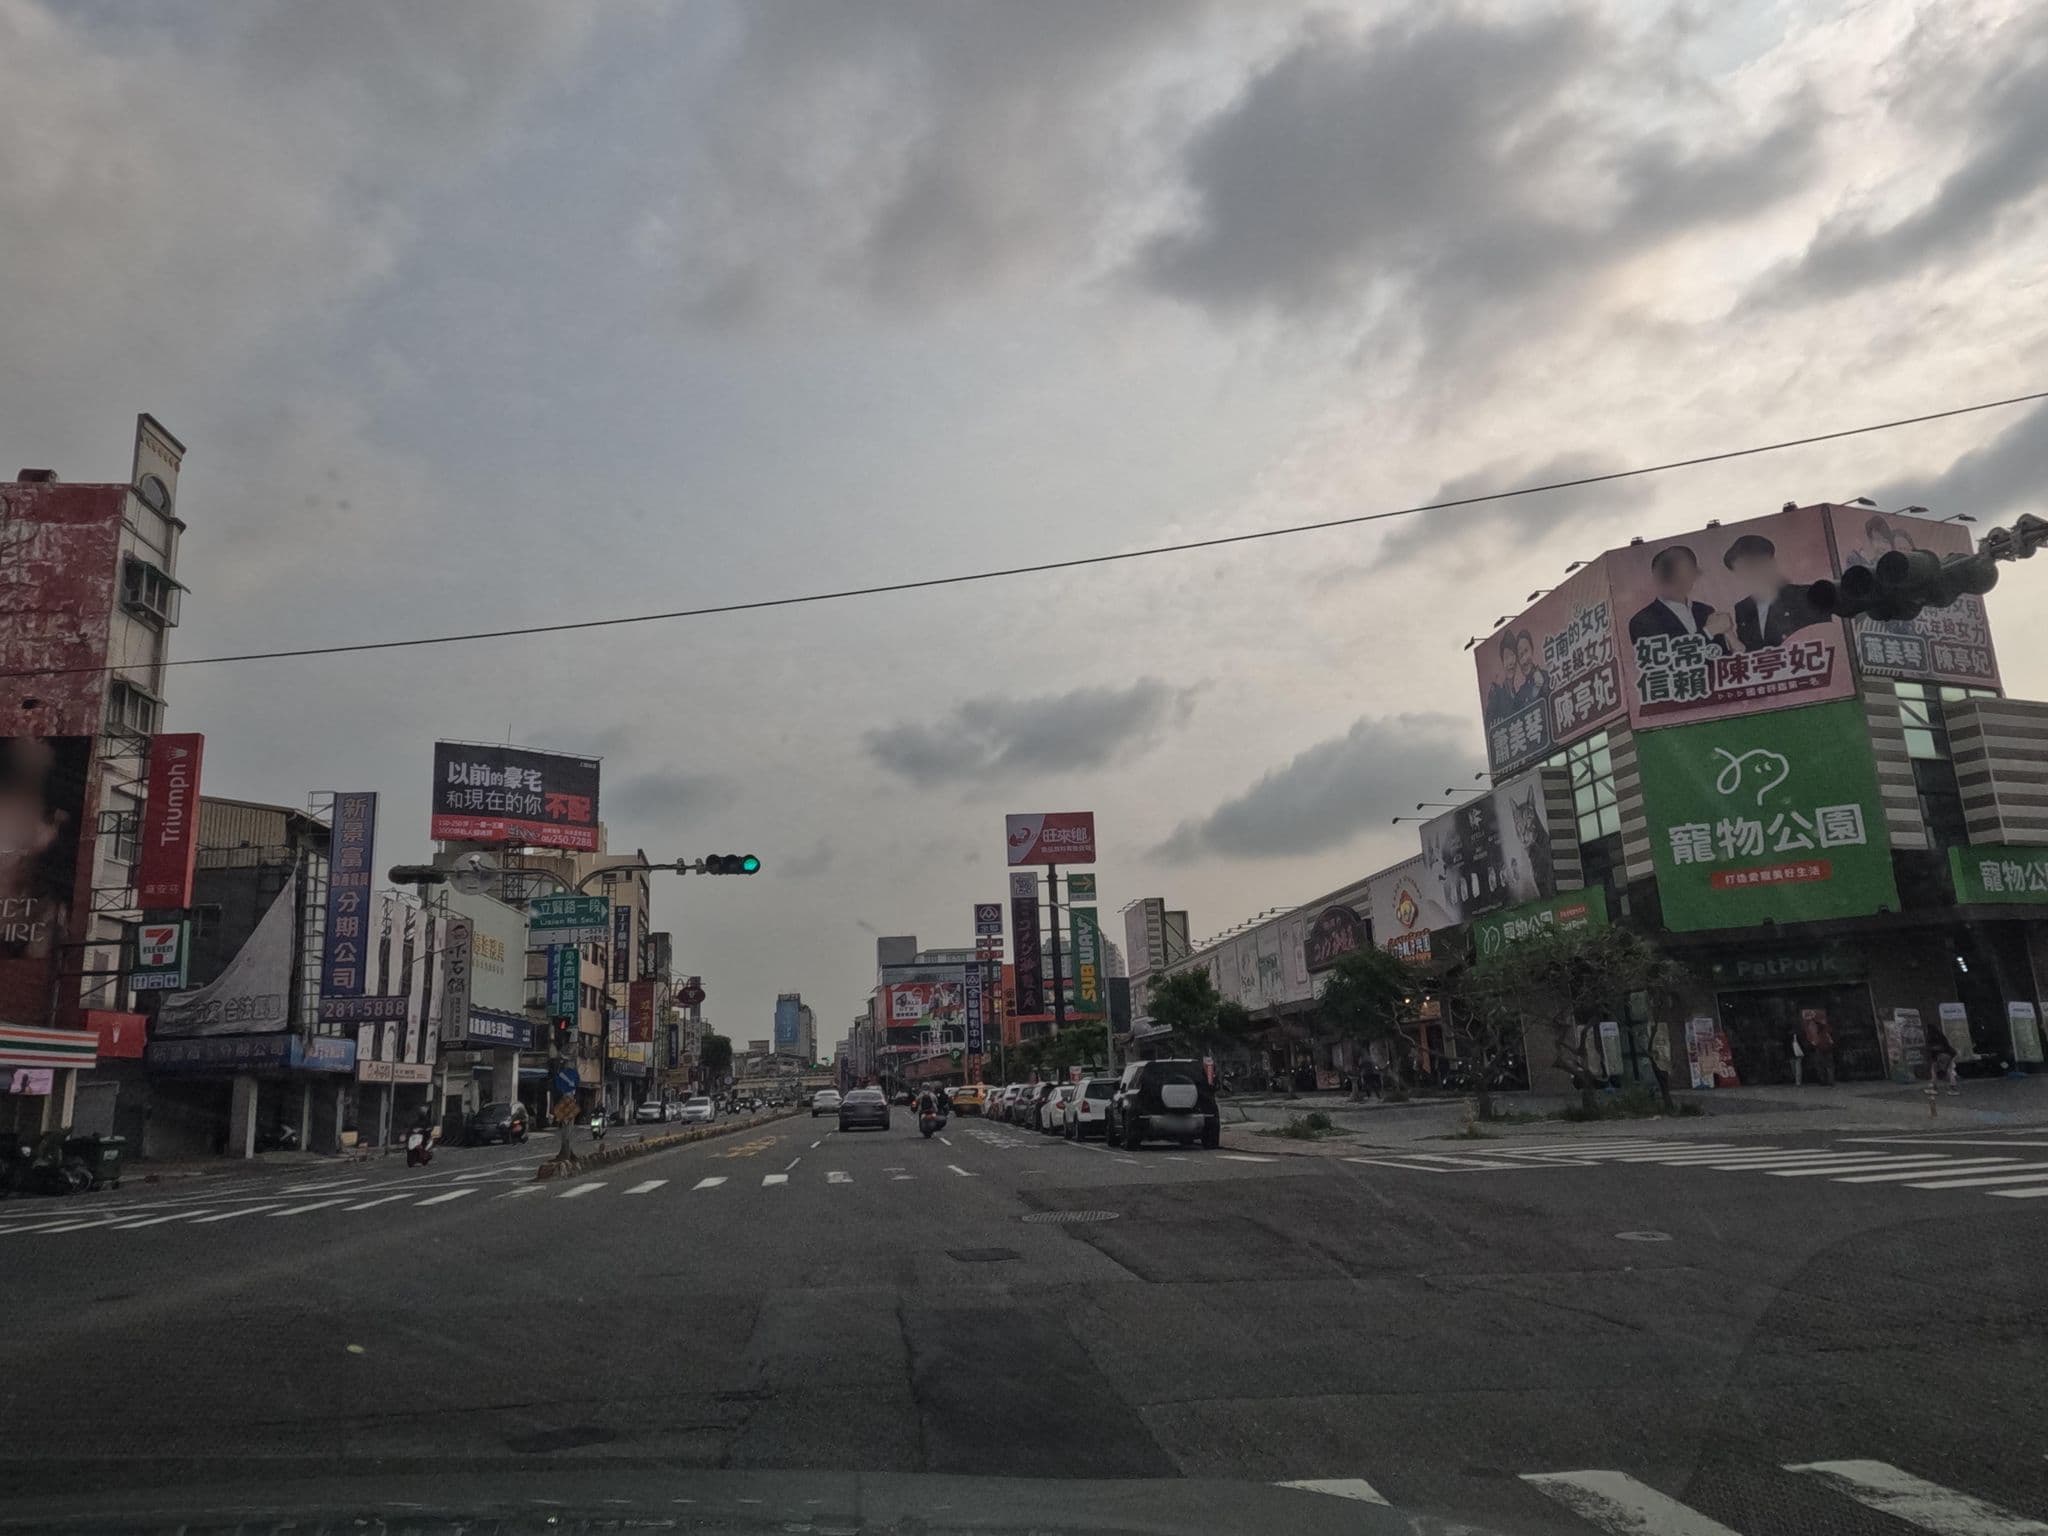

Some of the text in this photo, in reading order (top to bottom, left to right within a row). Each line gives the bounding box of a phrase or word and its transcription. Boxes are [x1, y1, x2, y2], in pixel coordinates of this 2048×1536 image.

[1543, 601, 1610, 661] 台南的女兒
[1864, 636, 1923, 667] 蕭美琴
[1916, 616, 1987, 646] 六年級女力
[1550, 636, 1613, 689] 六年級女力
[1637, 667, 1710, 701] 信賴
[1718, 640, 1826, 687] 陳亭妃
[1934, 645, 1991, 675] 陳亭妃
[1554, 667, 1617, 733] 陳亭妃
[1492, 707, 1544, 766] 蕭美琴
[447, 761, 543, 792] 以前的豪宅
[160, 763, 189, 847] Triumph
[446, 788, 593, 822] 和現在的你 不配
[341, 798, 368, 867] 新景富
[1042, 827, 1090, 844] 旺來鄉
[1668, 803, 1868, 865] 寵物公園
[331, 891, 361, 990] 分期公司
[1075, 915, 1098, 1003] SUBWAY
[324, 1000, 406, 1019] 281-5888
